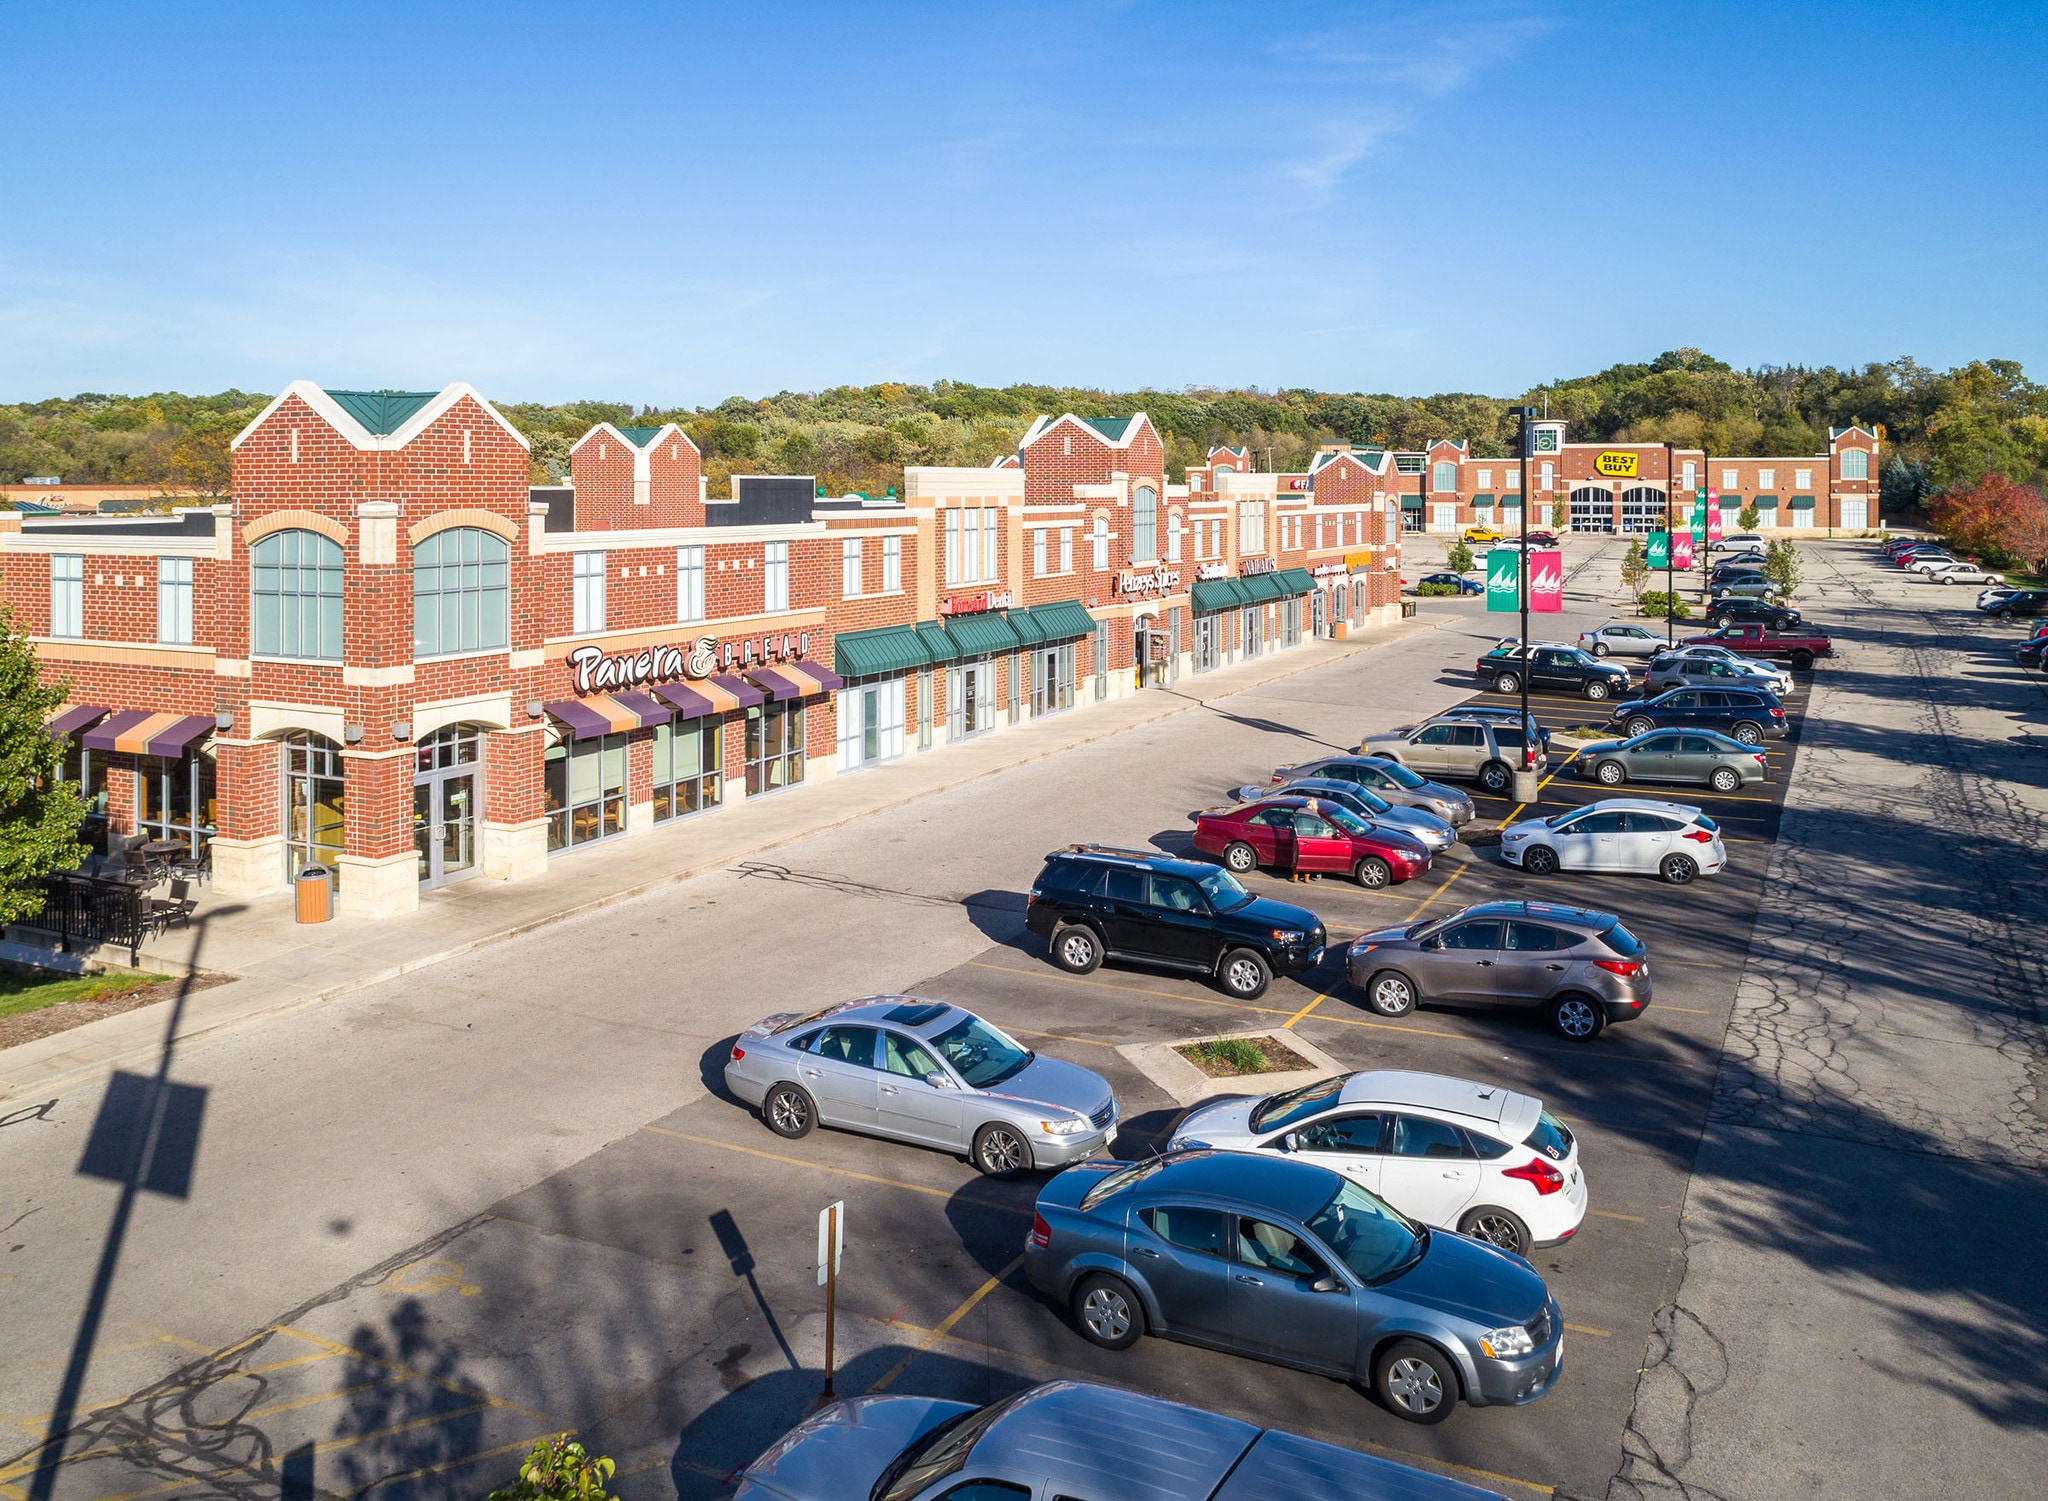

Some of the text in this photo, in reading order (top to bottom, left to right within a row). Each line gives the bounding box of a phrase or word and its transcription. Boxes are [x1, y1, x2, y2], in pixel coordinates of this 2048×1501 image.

[1603, 455, 1636, 464] BEST
[1604, 464, 1632, 472] BUY
[1119, 571, 1154, 595] Penzeys
[1155, 567, 1180, 592] Spices
[951, 588, 1015, 614] Forward Dental
[572, 632, 809, 691] Panera BREAD
